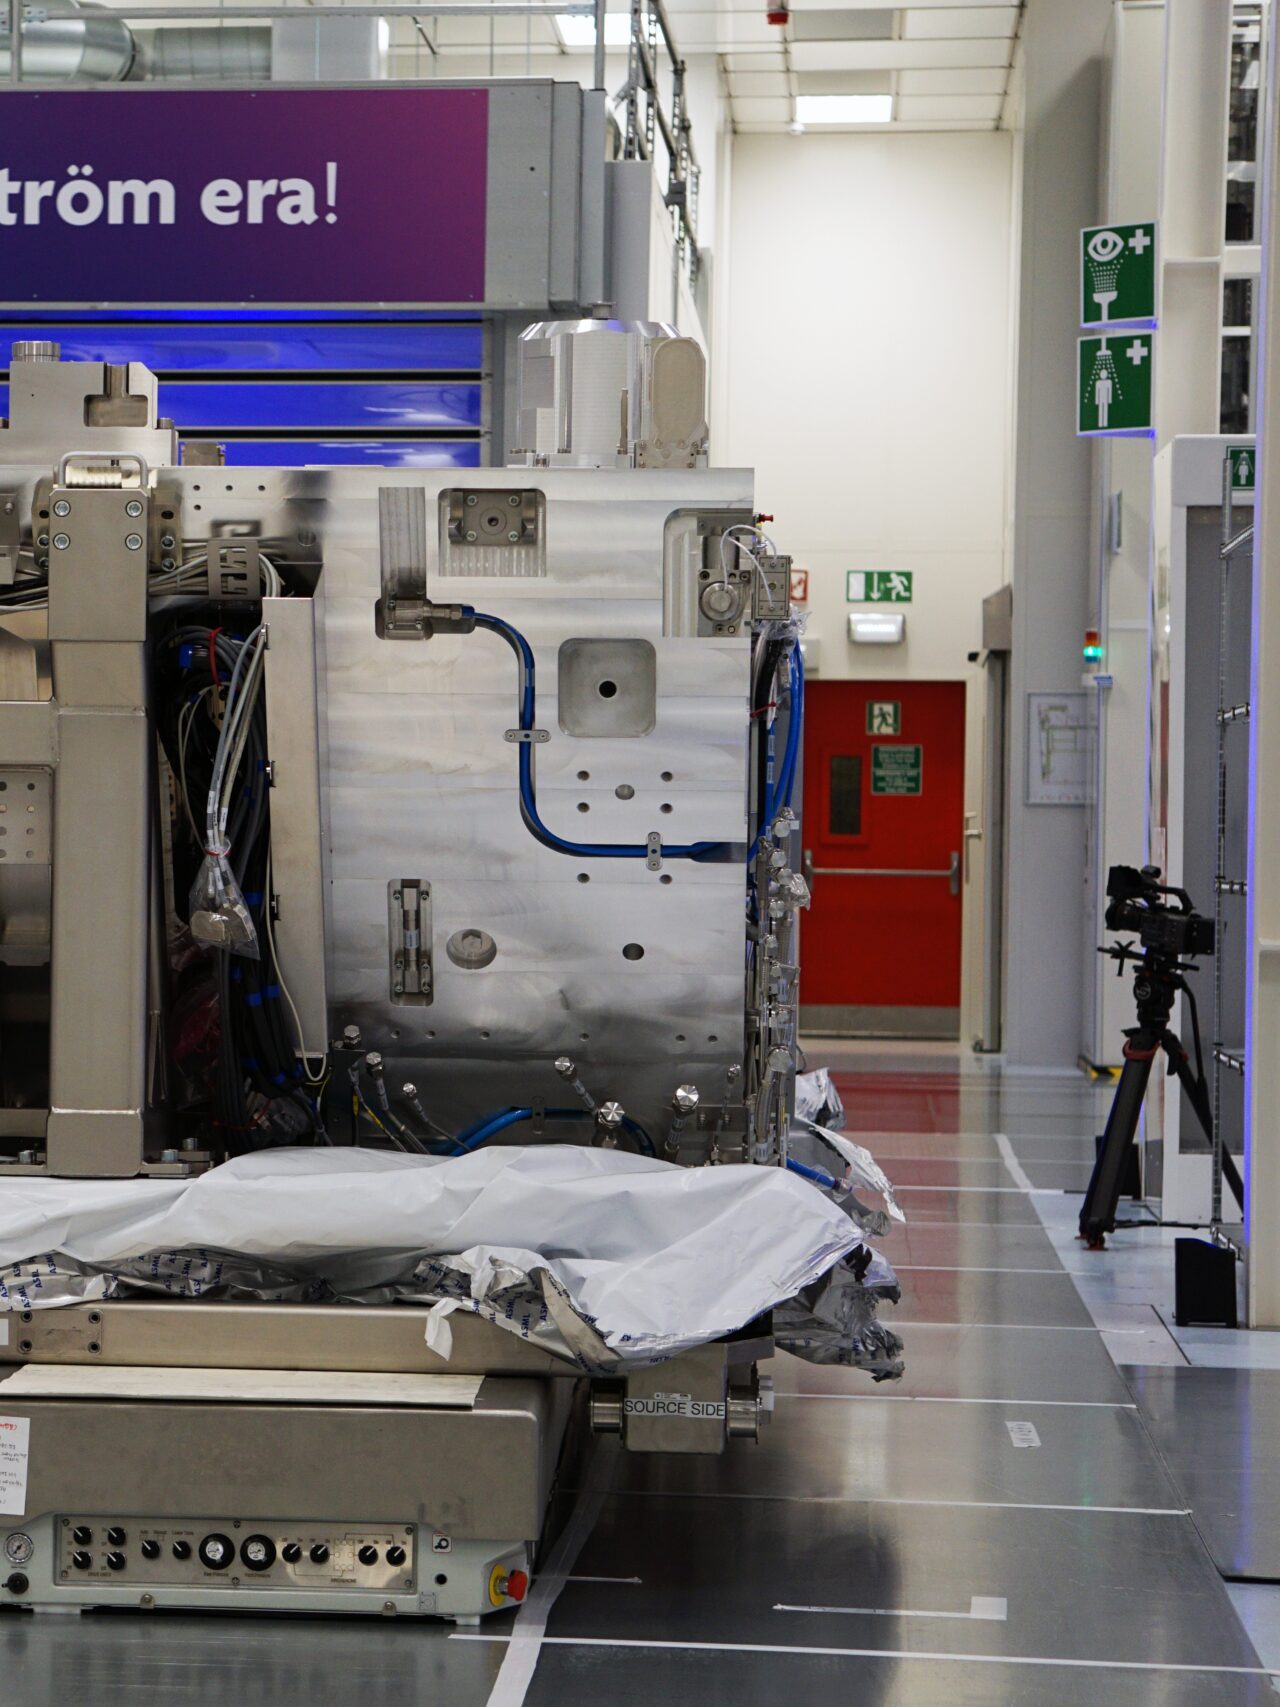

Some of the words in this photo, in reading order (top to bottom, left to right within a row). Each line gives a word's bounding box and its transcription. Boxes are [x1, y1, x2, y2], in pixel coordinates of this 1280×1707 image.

[200, 161, 339, 226] era!
[624, 1400, 687, 1414] SOURCE
[691, 1403, 725, 1417] SIDE
